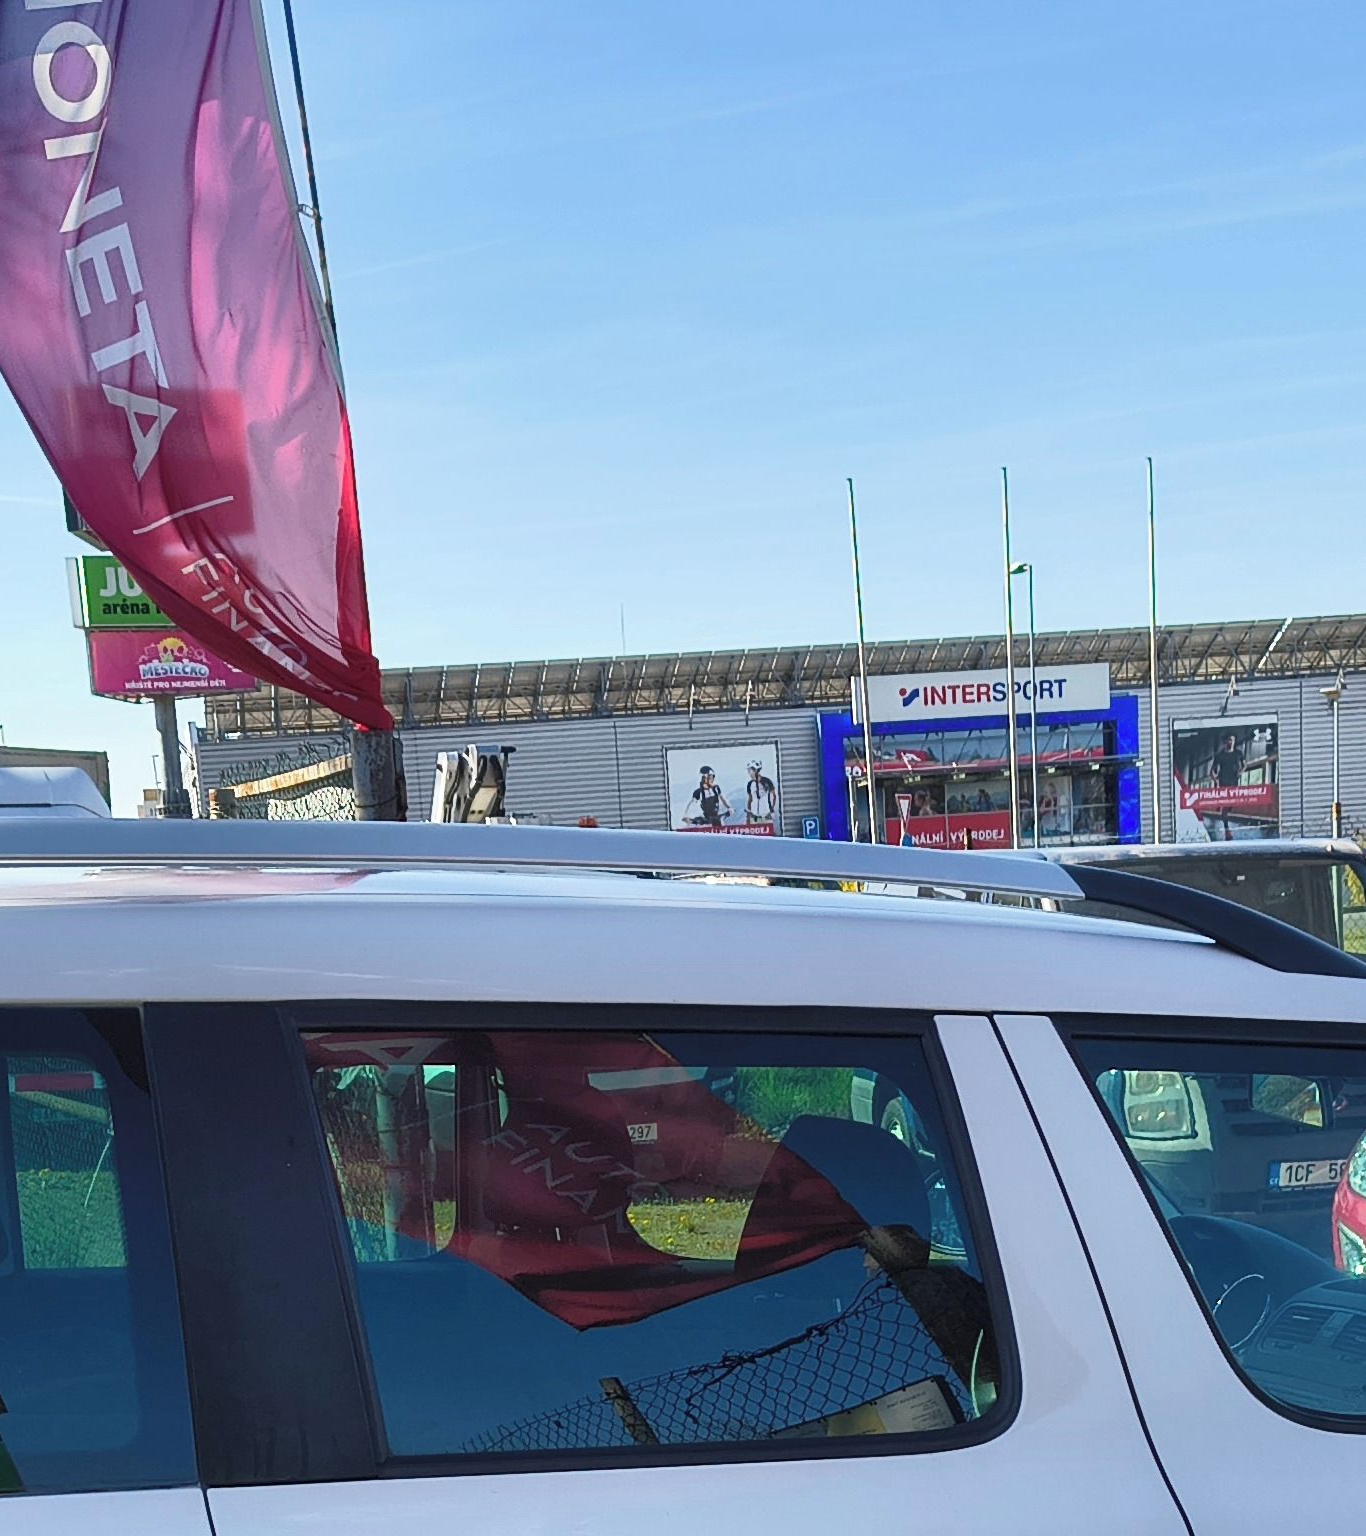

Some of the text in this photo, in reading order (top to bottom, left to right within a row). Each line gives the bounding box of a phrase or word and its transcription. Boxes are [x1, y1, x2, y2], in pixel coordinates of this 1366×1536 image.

[25, 0, 178, 482] ONETA
[99, 567, 143, 597] JU
[102, 598, 150, 615] aréna
[154, 681, 169, 689] PRO
[923, 678, 1067, 706] INTERSPORT
[911, 827, 1005, 846] NÁLNÍ VÝRODEJ
[1285, 1163, 1316, 1184] 1CF
